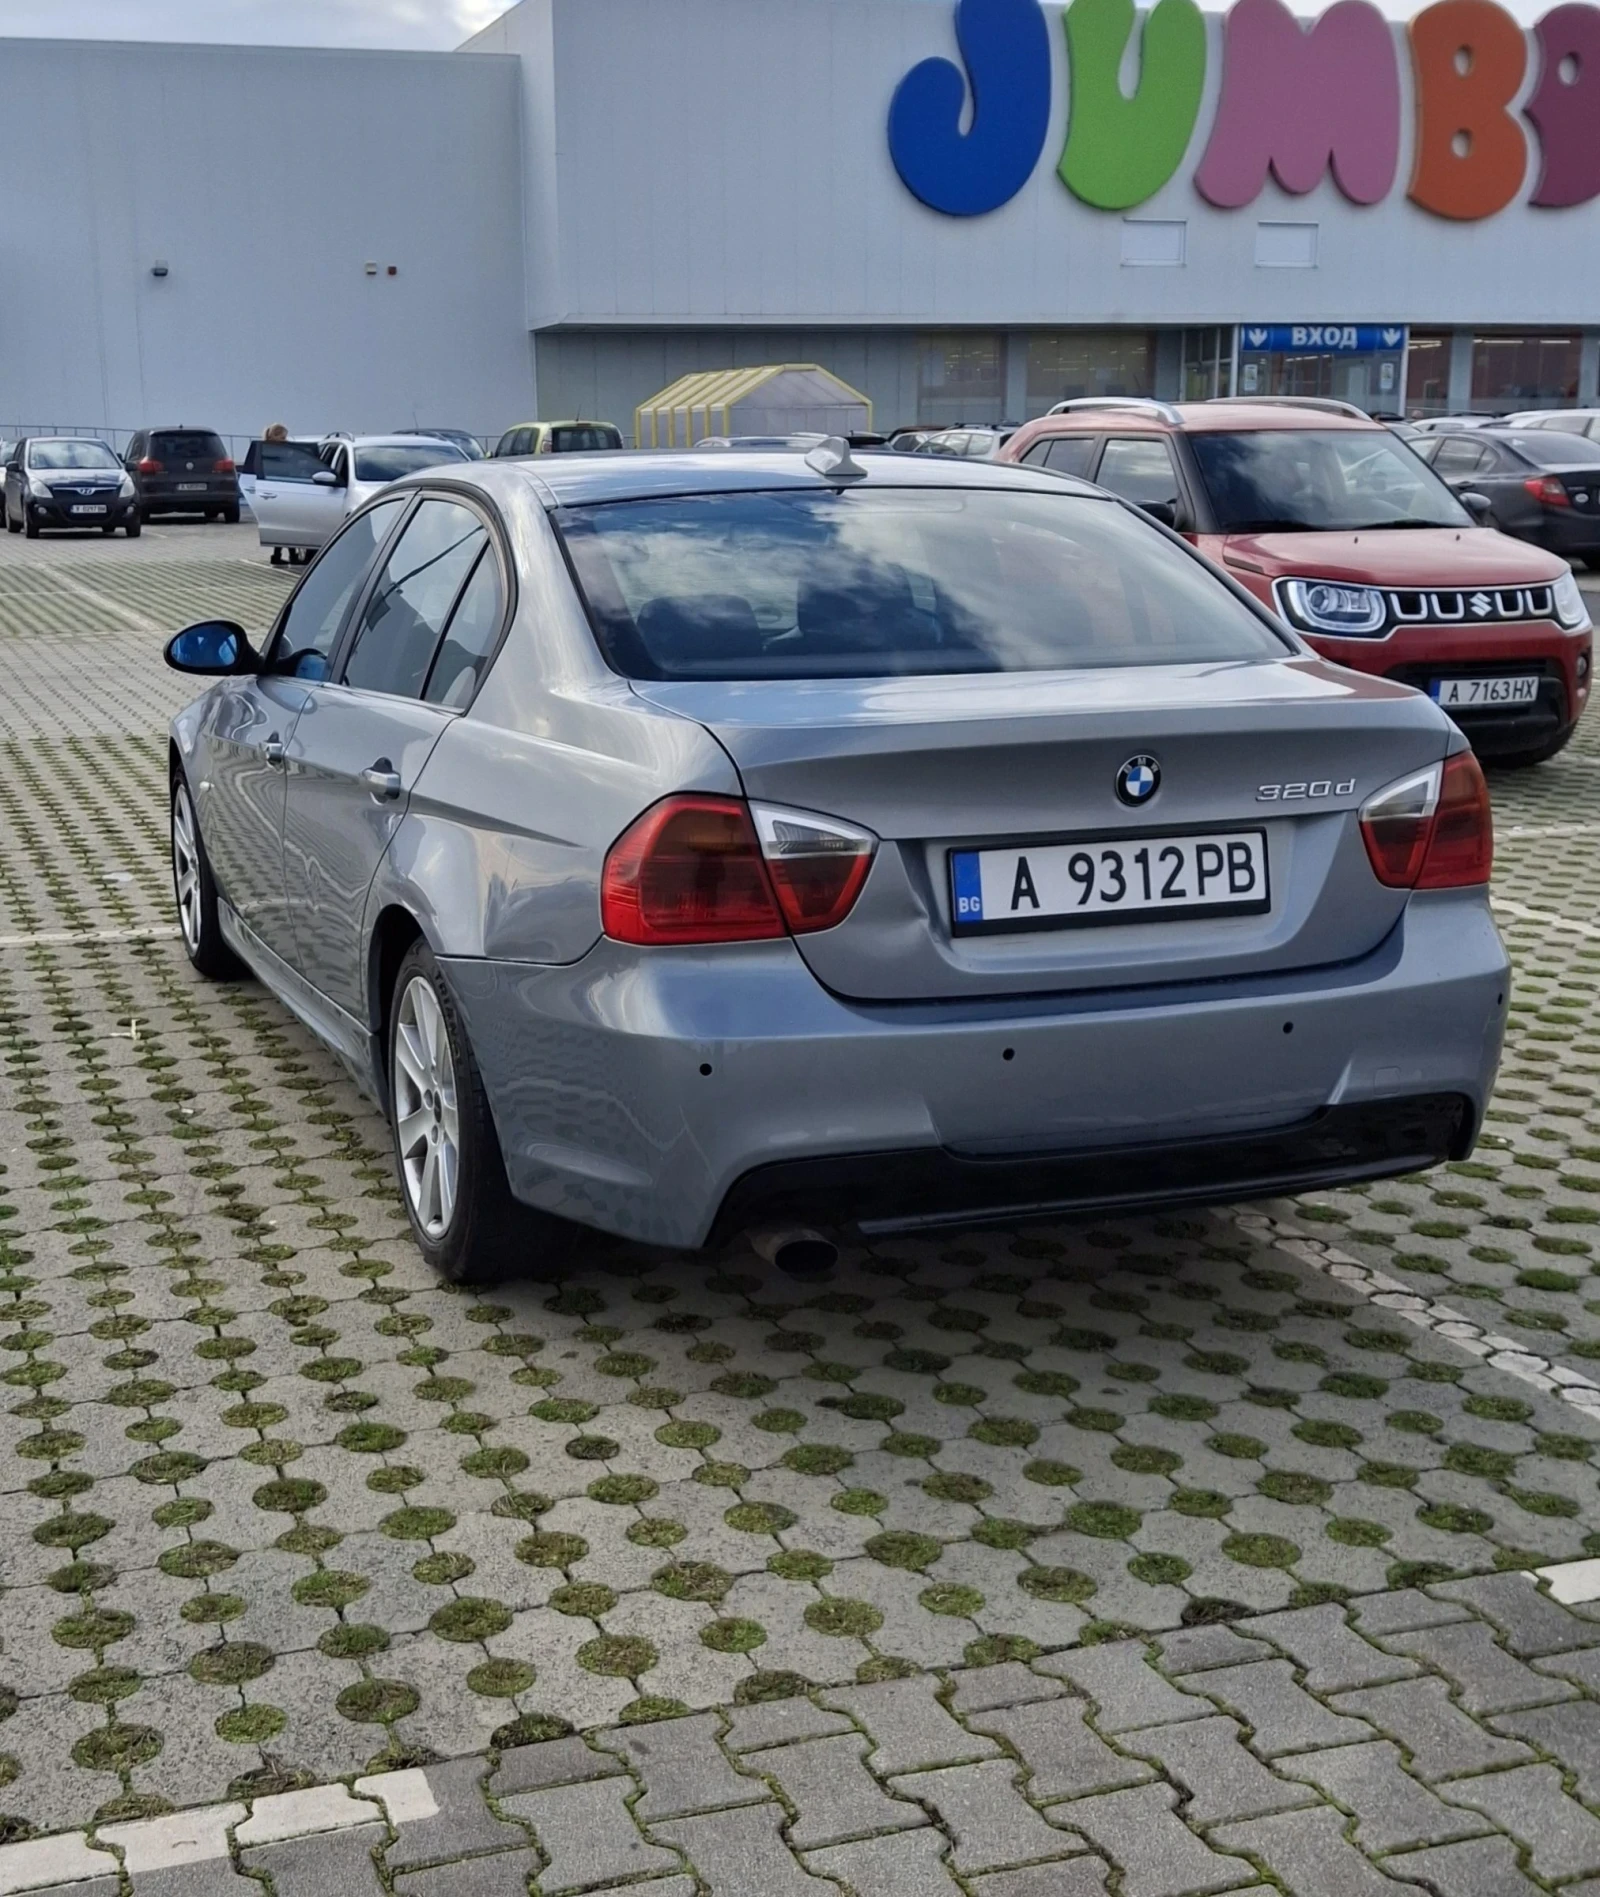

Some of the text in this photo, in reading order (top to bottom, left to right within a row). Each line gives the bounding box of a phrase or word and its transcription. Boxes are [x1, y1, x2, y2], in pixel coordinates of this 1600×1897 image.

[1291, 326, 1358, 349] ВХОД
[1448, 679, 1535, 702] A 7163HX
[1256, 778, 1356, 802] 320d
[1010, 841, 1256, 911] A 9312PB
[958, 896, 981, 914] BG
